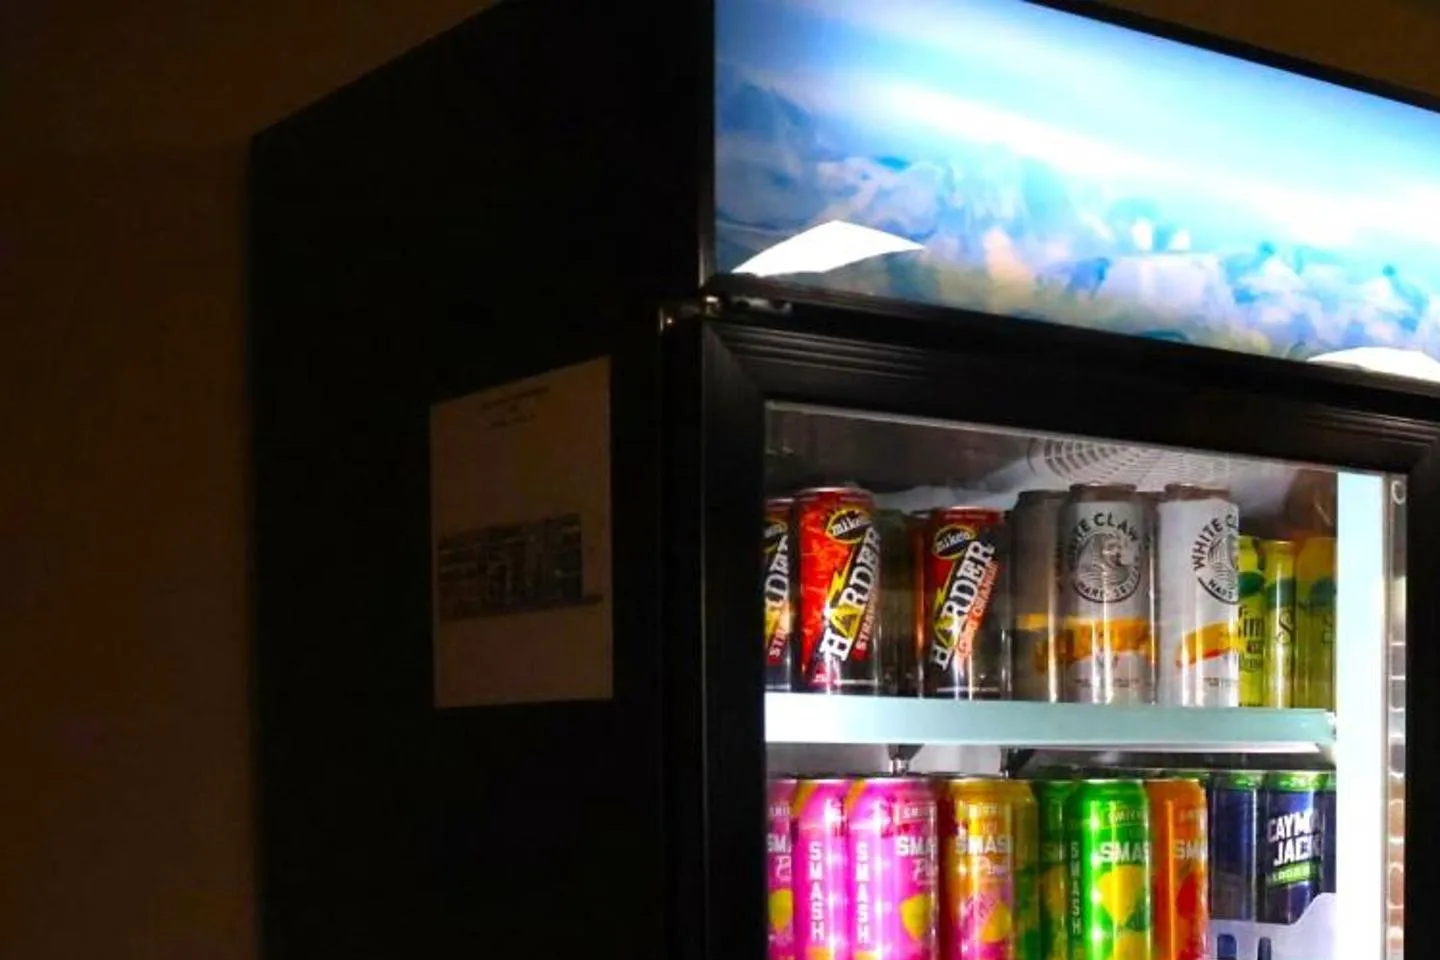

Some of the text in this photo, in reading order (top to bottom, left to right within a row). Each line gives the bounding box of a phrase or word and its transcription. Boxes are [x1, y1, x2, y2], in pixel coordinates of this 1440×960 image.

[1093, 512, 1139, 542] CLAW
[1193, 516, 1226, 571] WHITE
[932, 541, 996, 672] HARDER
[1266, 811, 1322, 842] CAYM
[809, 842, 825, 942] SMASH
[855, 842, 870, 945] SMASH
